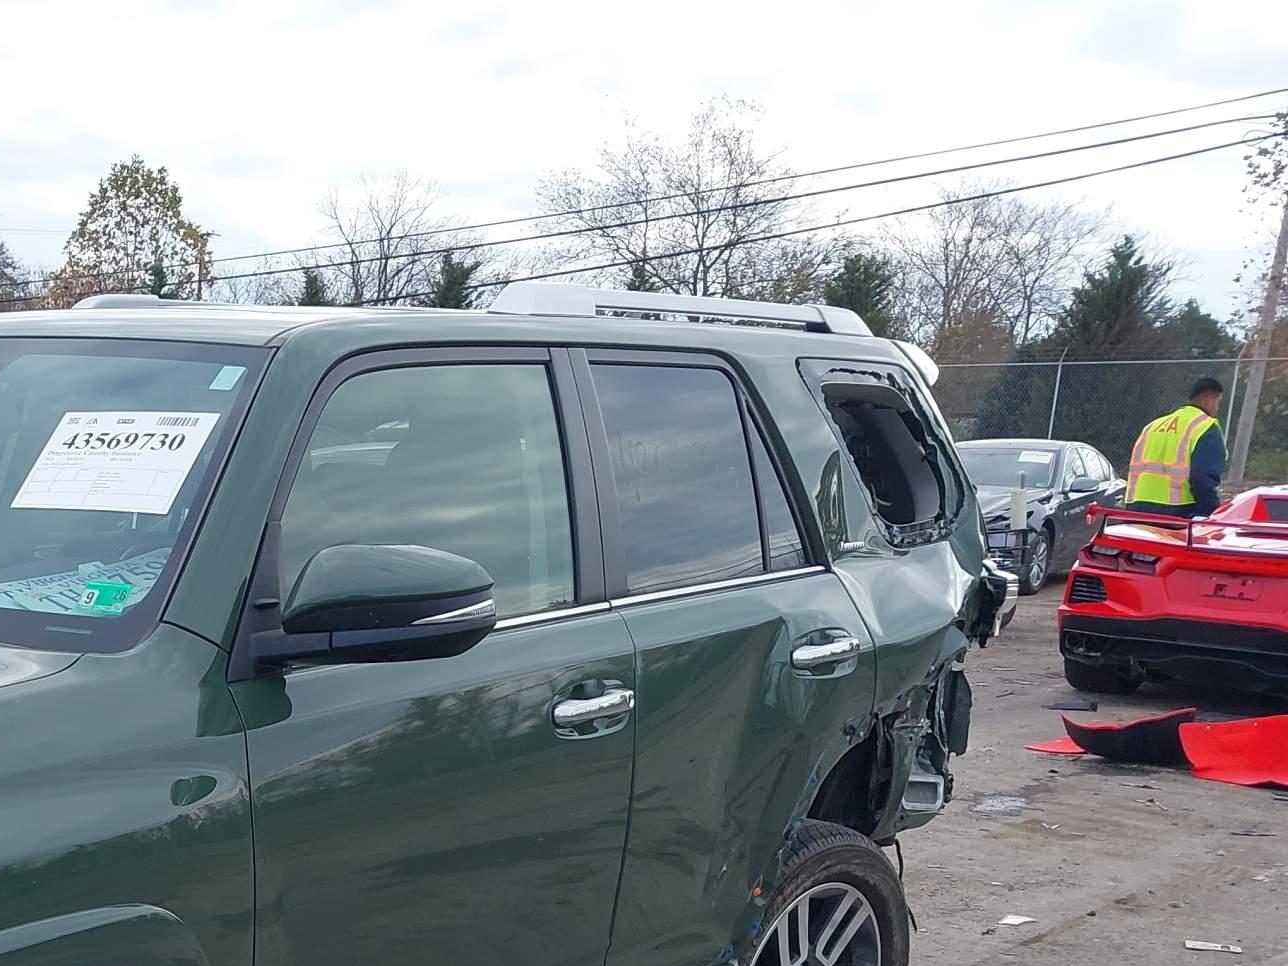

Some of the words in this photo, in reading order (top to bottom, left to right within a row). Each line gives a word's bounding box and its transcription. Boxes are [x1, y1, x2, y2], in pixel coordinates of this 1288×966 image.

[62, 432, 186, 451] 43569730
[18, 573, 76, 590] VIRGIN
[84, 591, 95, 605] 9
